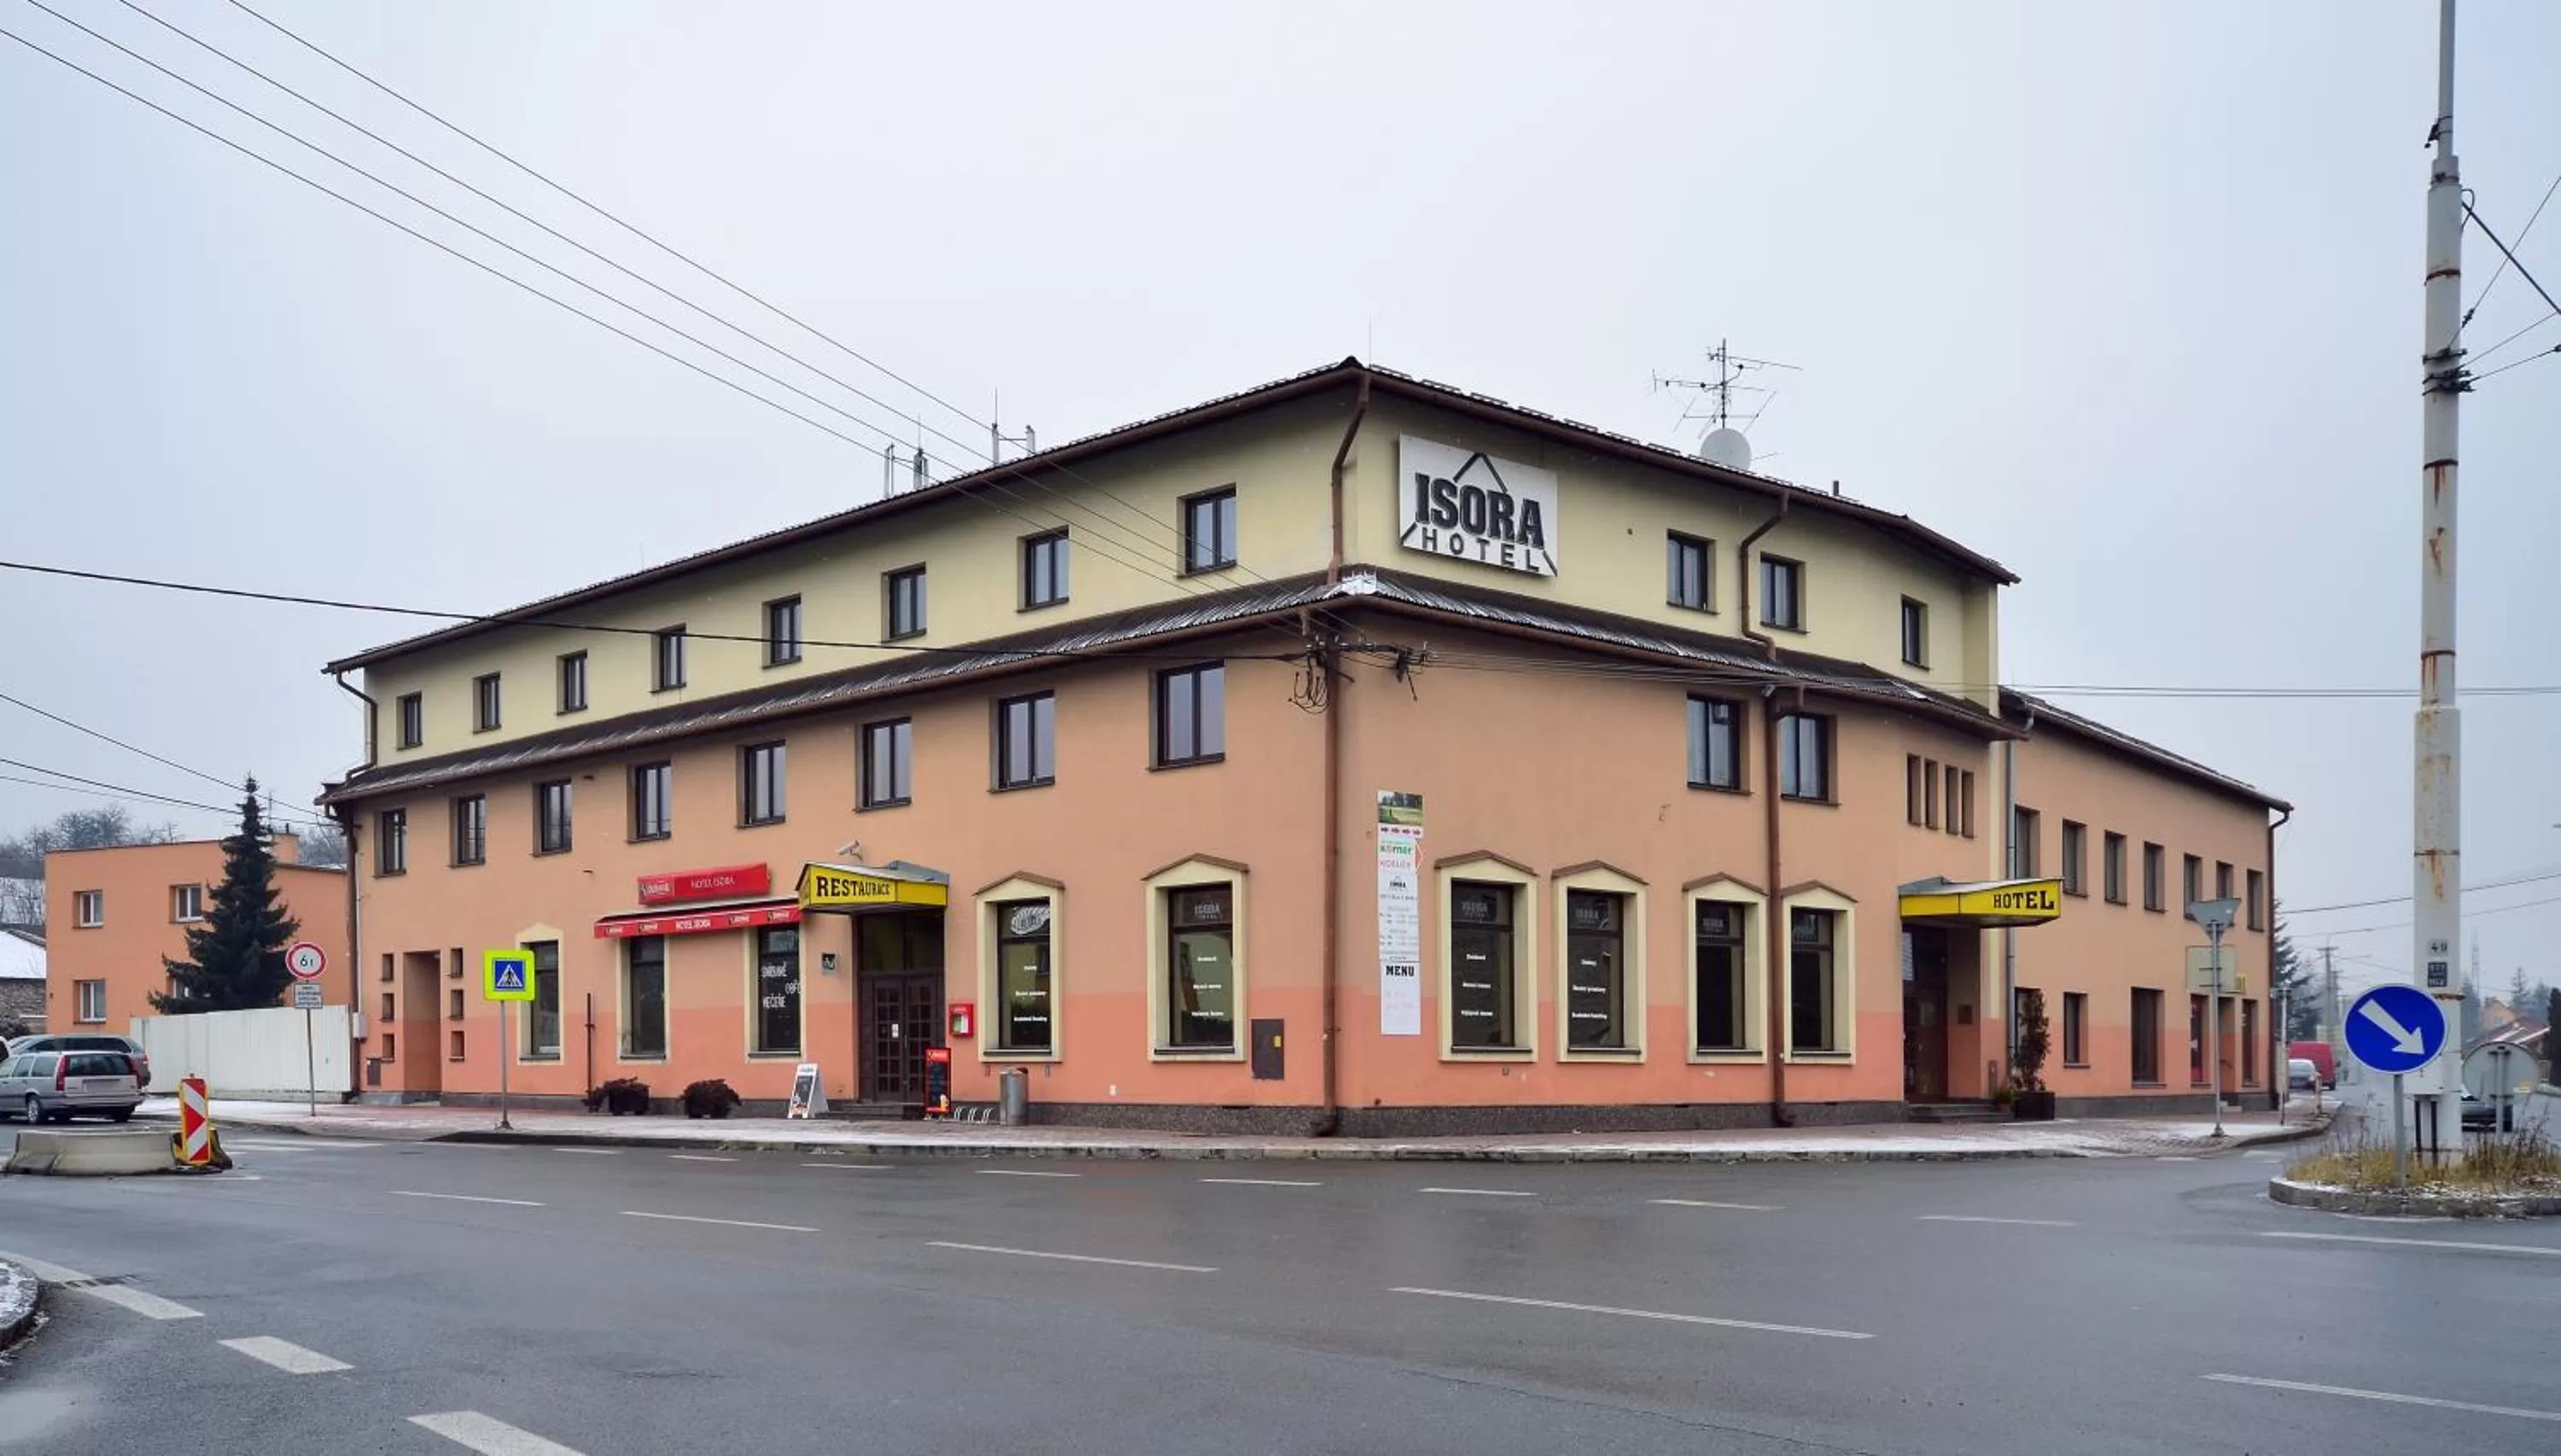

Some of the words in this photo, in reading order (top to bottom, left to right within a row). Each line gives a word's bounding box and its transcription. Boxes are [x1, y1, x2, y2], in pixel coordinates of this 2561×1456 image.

[1415, 471, 1544, 549] ISORA
[1421, 527, 1540, 573] HOTEL
[815, 876, 890, 897] RESTAURACE
[1992, 890, 2055, 911] HOTEL
[1386, 965, 1415, 977] MENU
